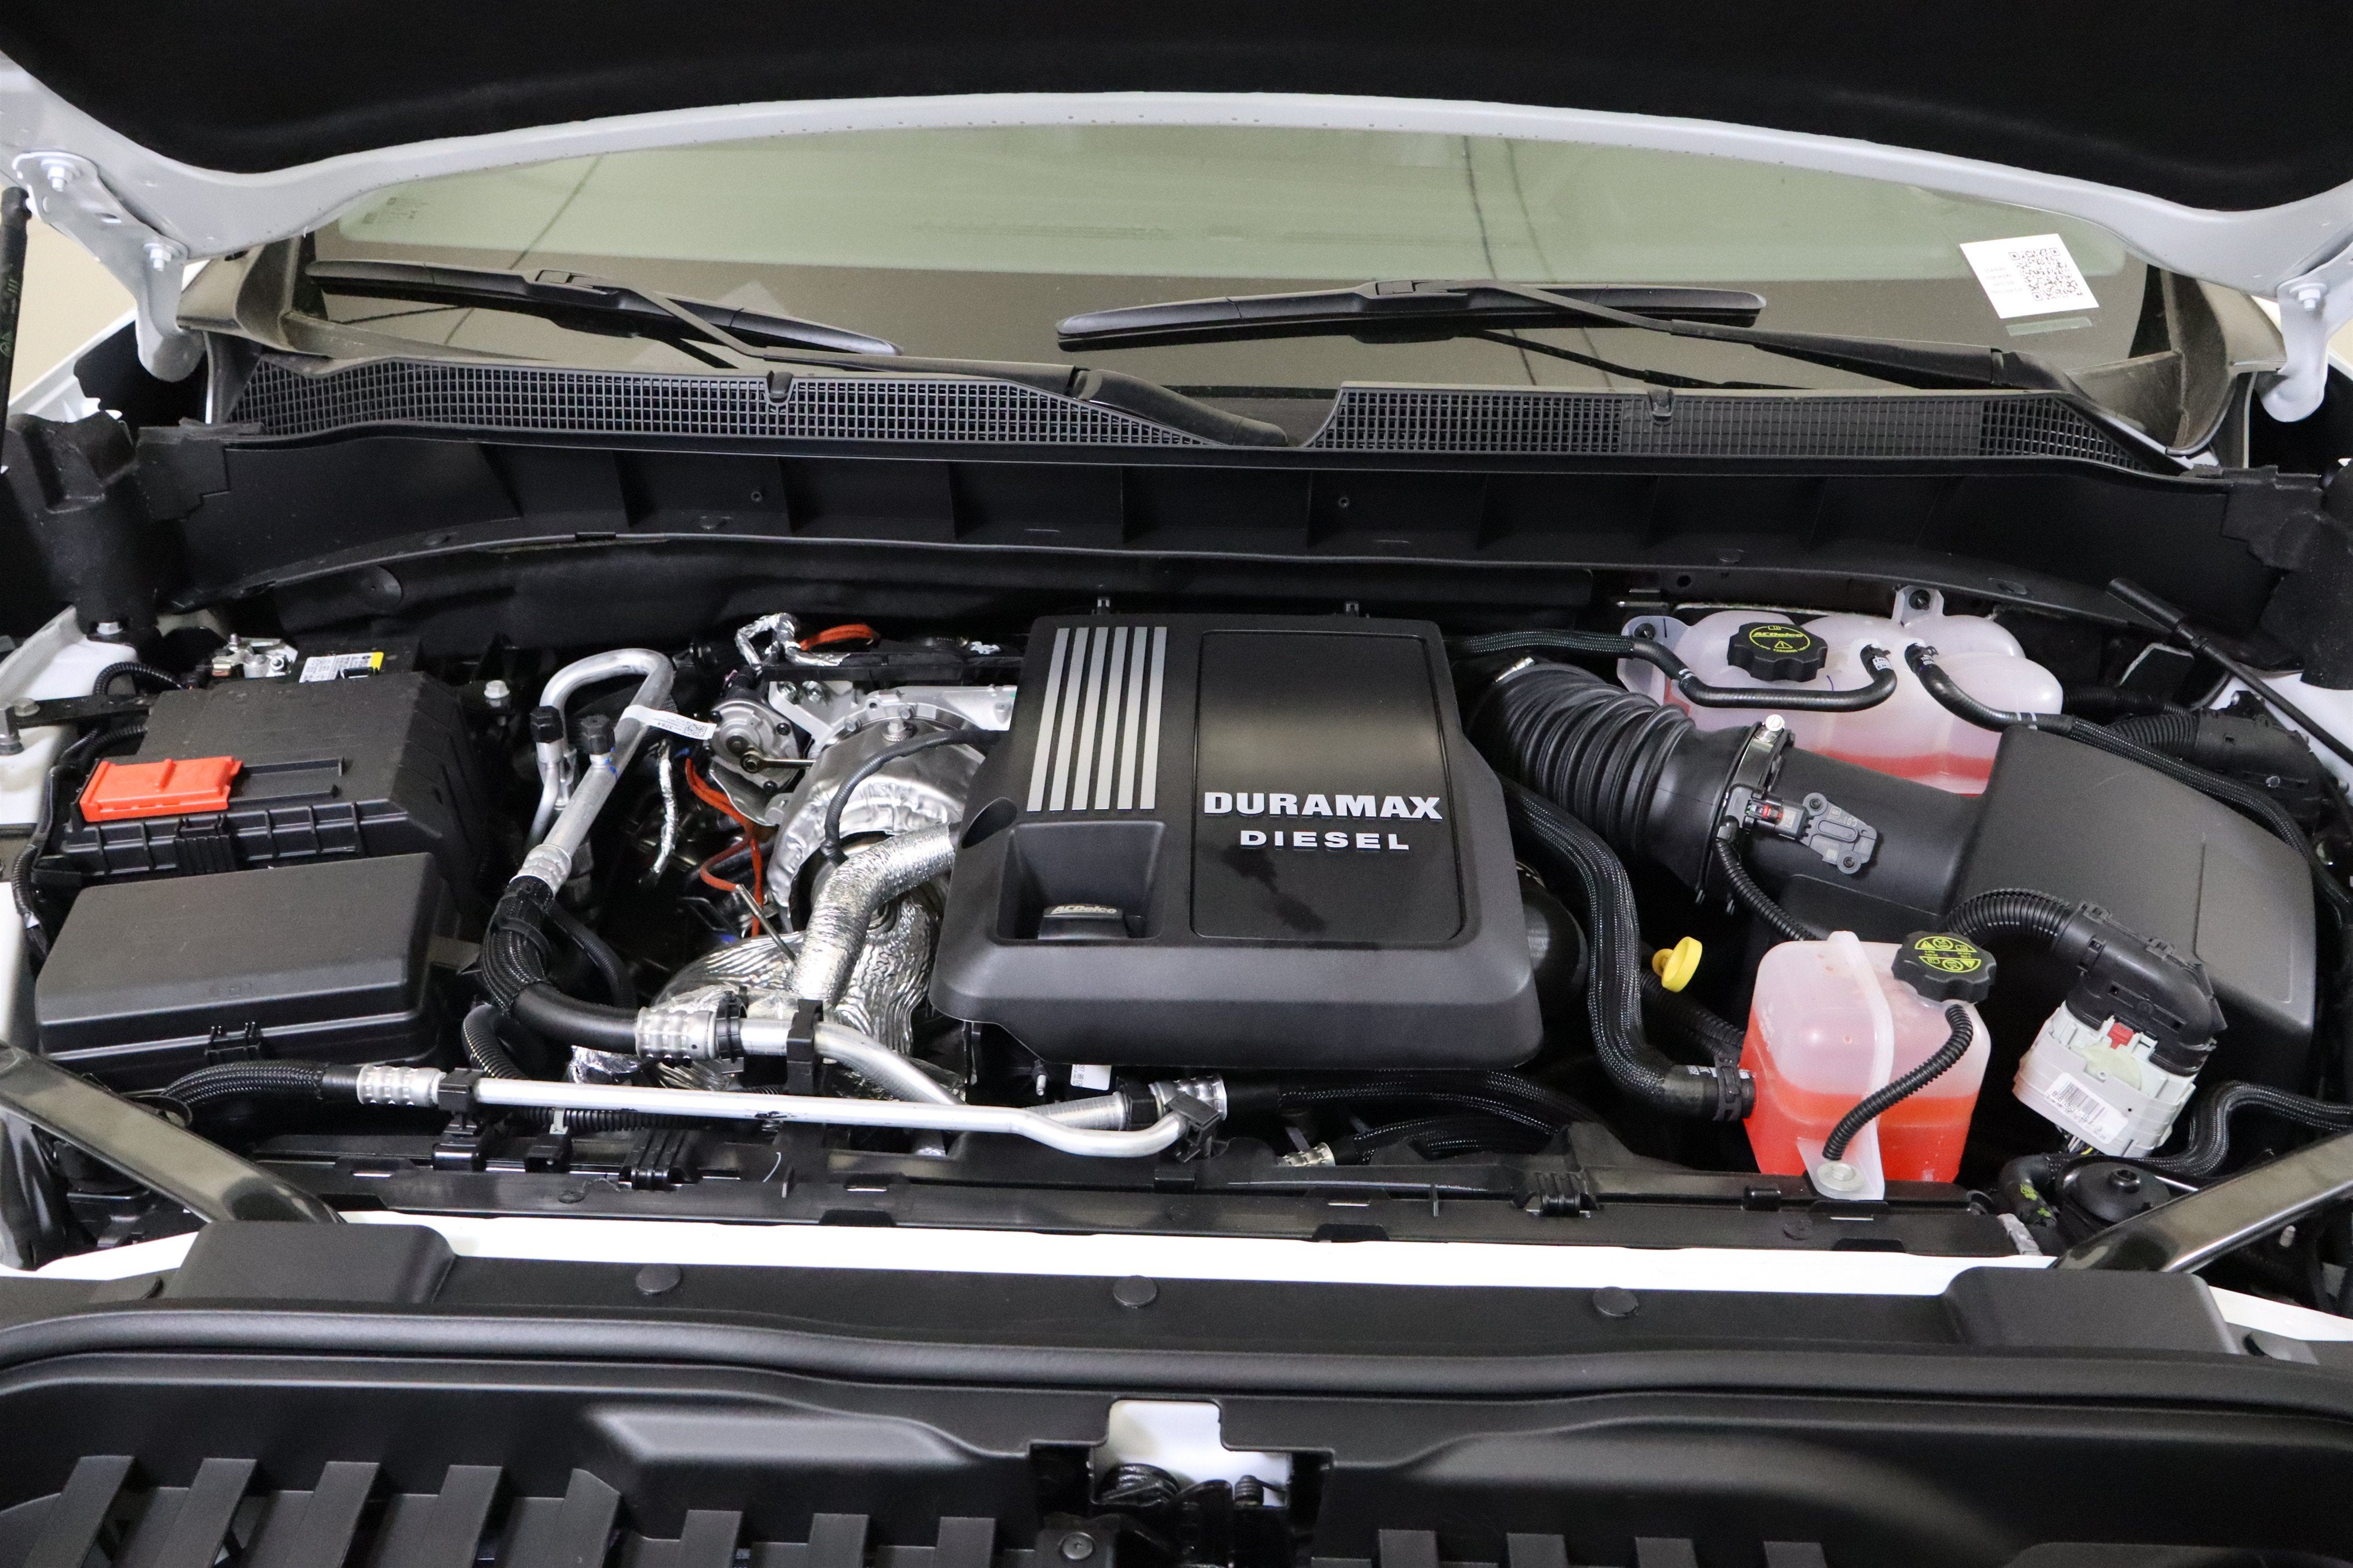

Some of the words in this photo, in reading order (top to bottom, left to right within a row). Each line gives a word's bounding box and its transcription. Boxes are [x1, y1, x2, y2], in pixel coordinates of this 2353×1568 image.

[1204, 791, 1443, 820] DURAMAX
[1240, 829, 1410, 851] DIESEL
[1050, 905, 1117, 915] ACDelco
